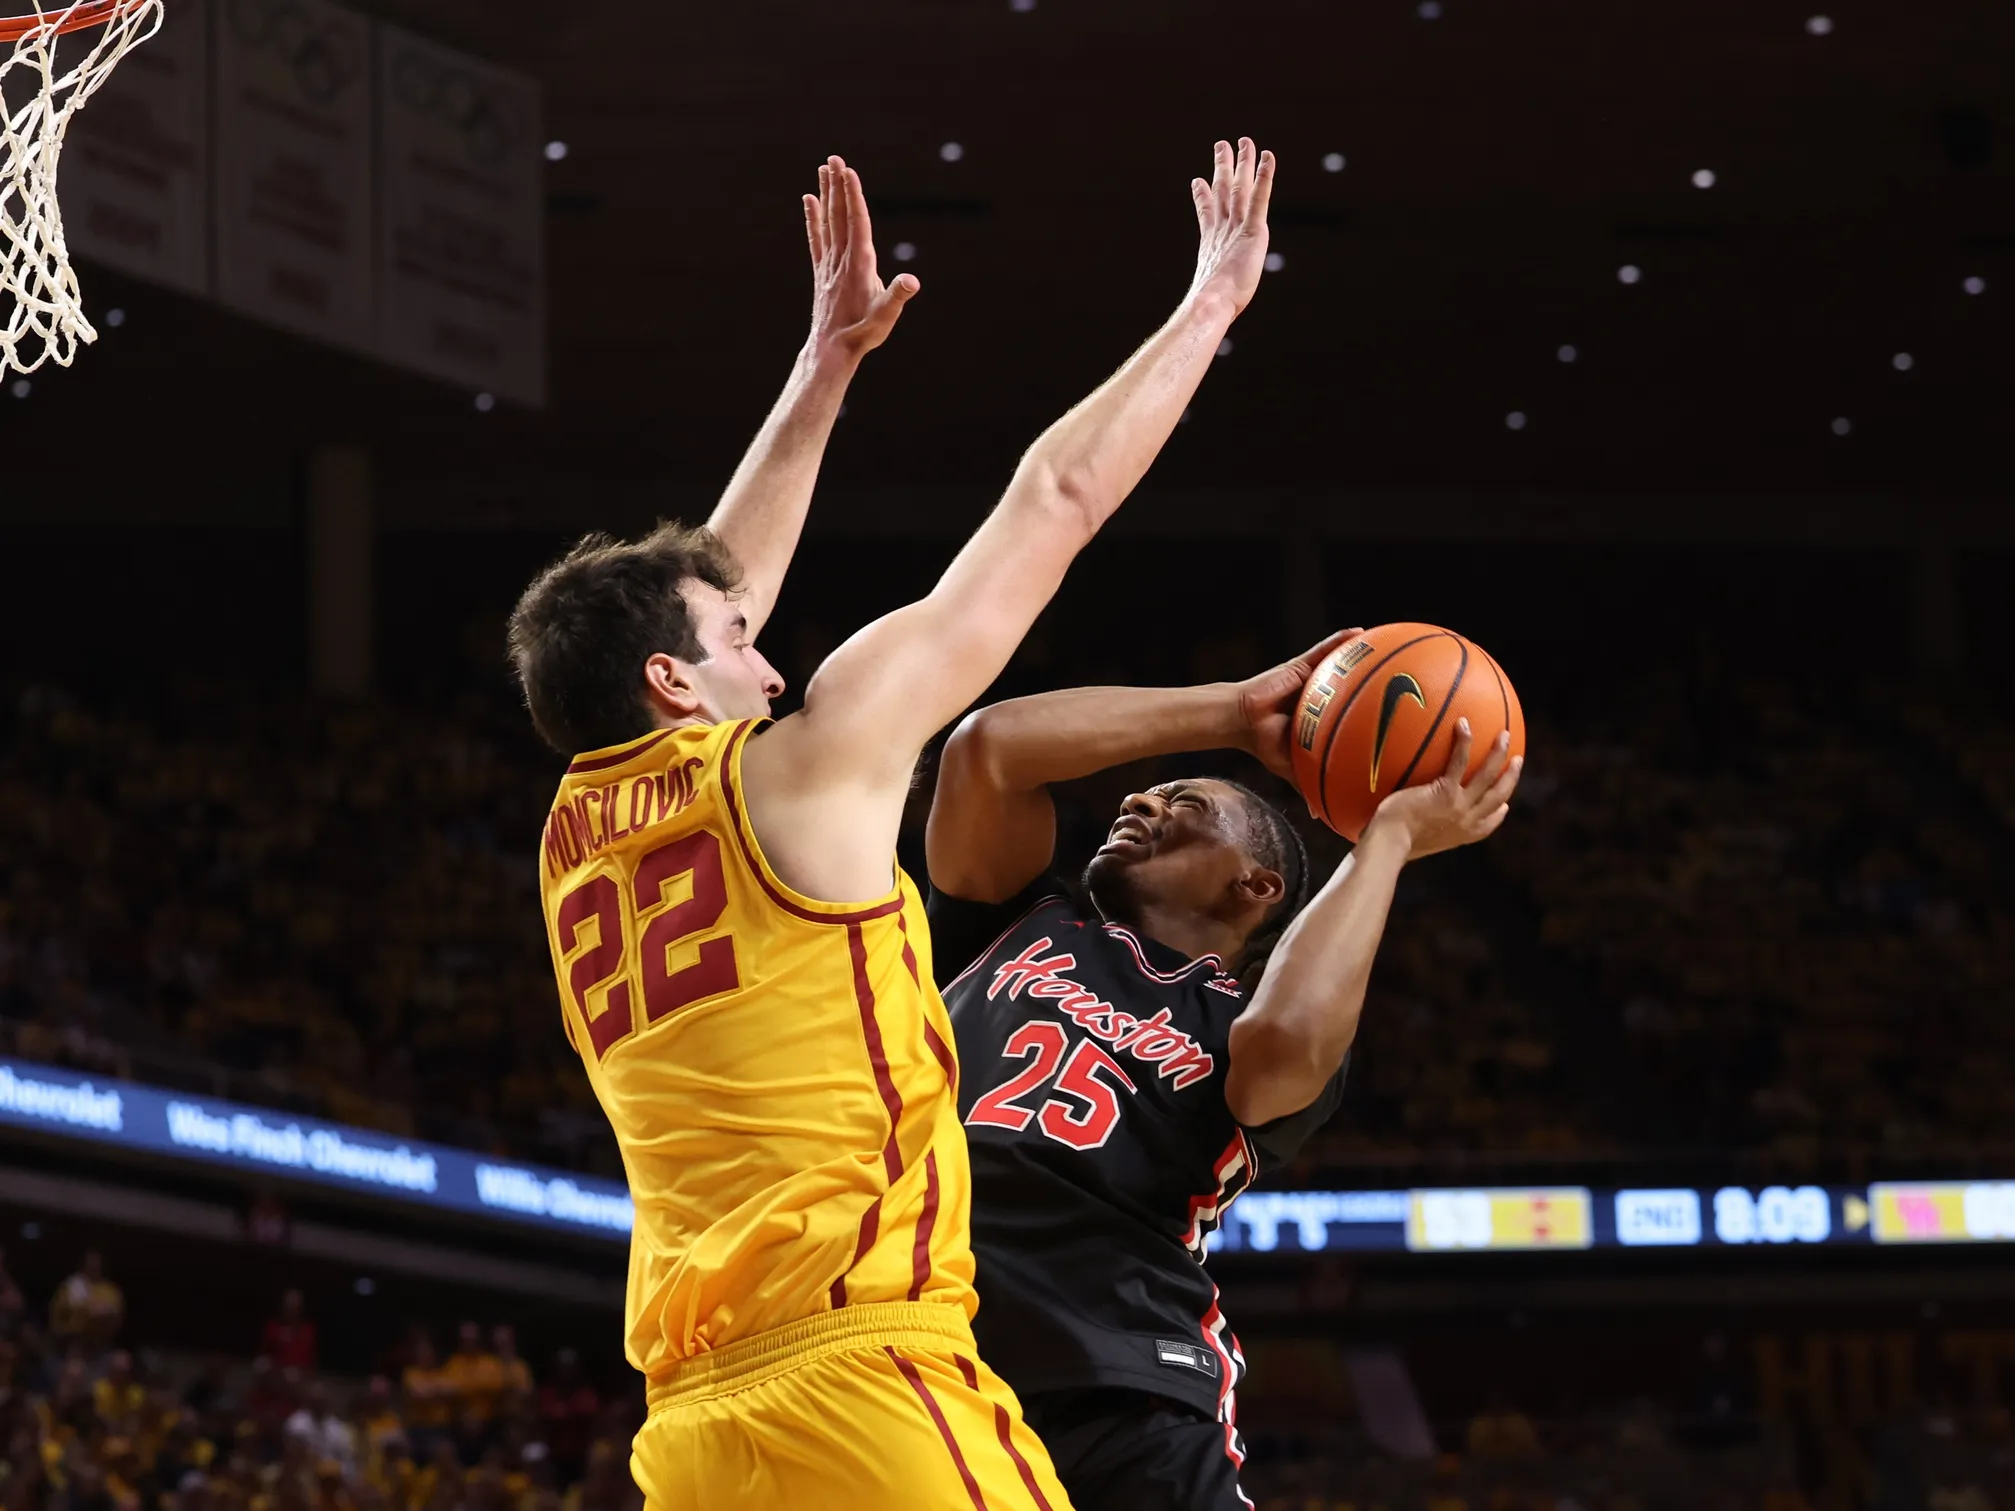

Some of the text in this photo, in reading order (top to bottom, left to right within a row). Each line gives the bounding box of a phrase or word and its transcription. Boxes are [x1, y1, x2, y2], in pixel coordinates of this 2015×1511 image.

[557, 828, 742, 1065] 22
[986, 935, 1215, 1093] Houston
[0, 1064, 124, 1132] hevrolet
[963, 1020, 1139, 1151] 25
[547, 1177, 636, 1232] Chevro
[1201, 1353, 1211, 1367] L
